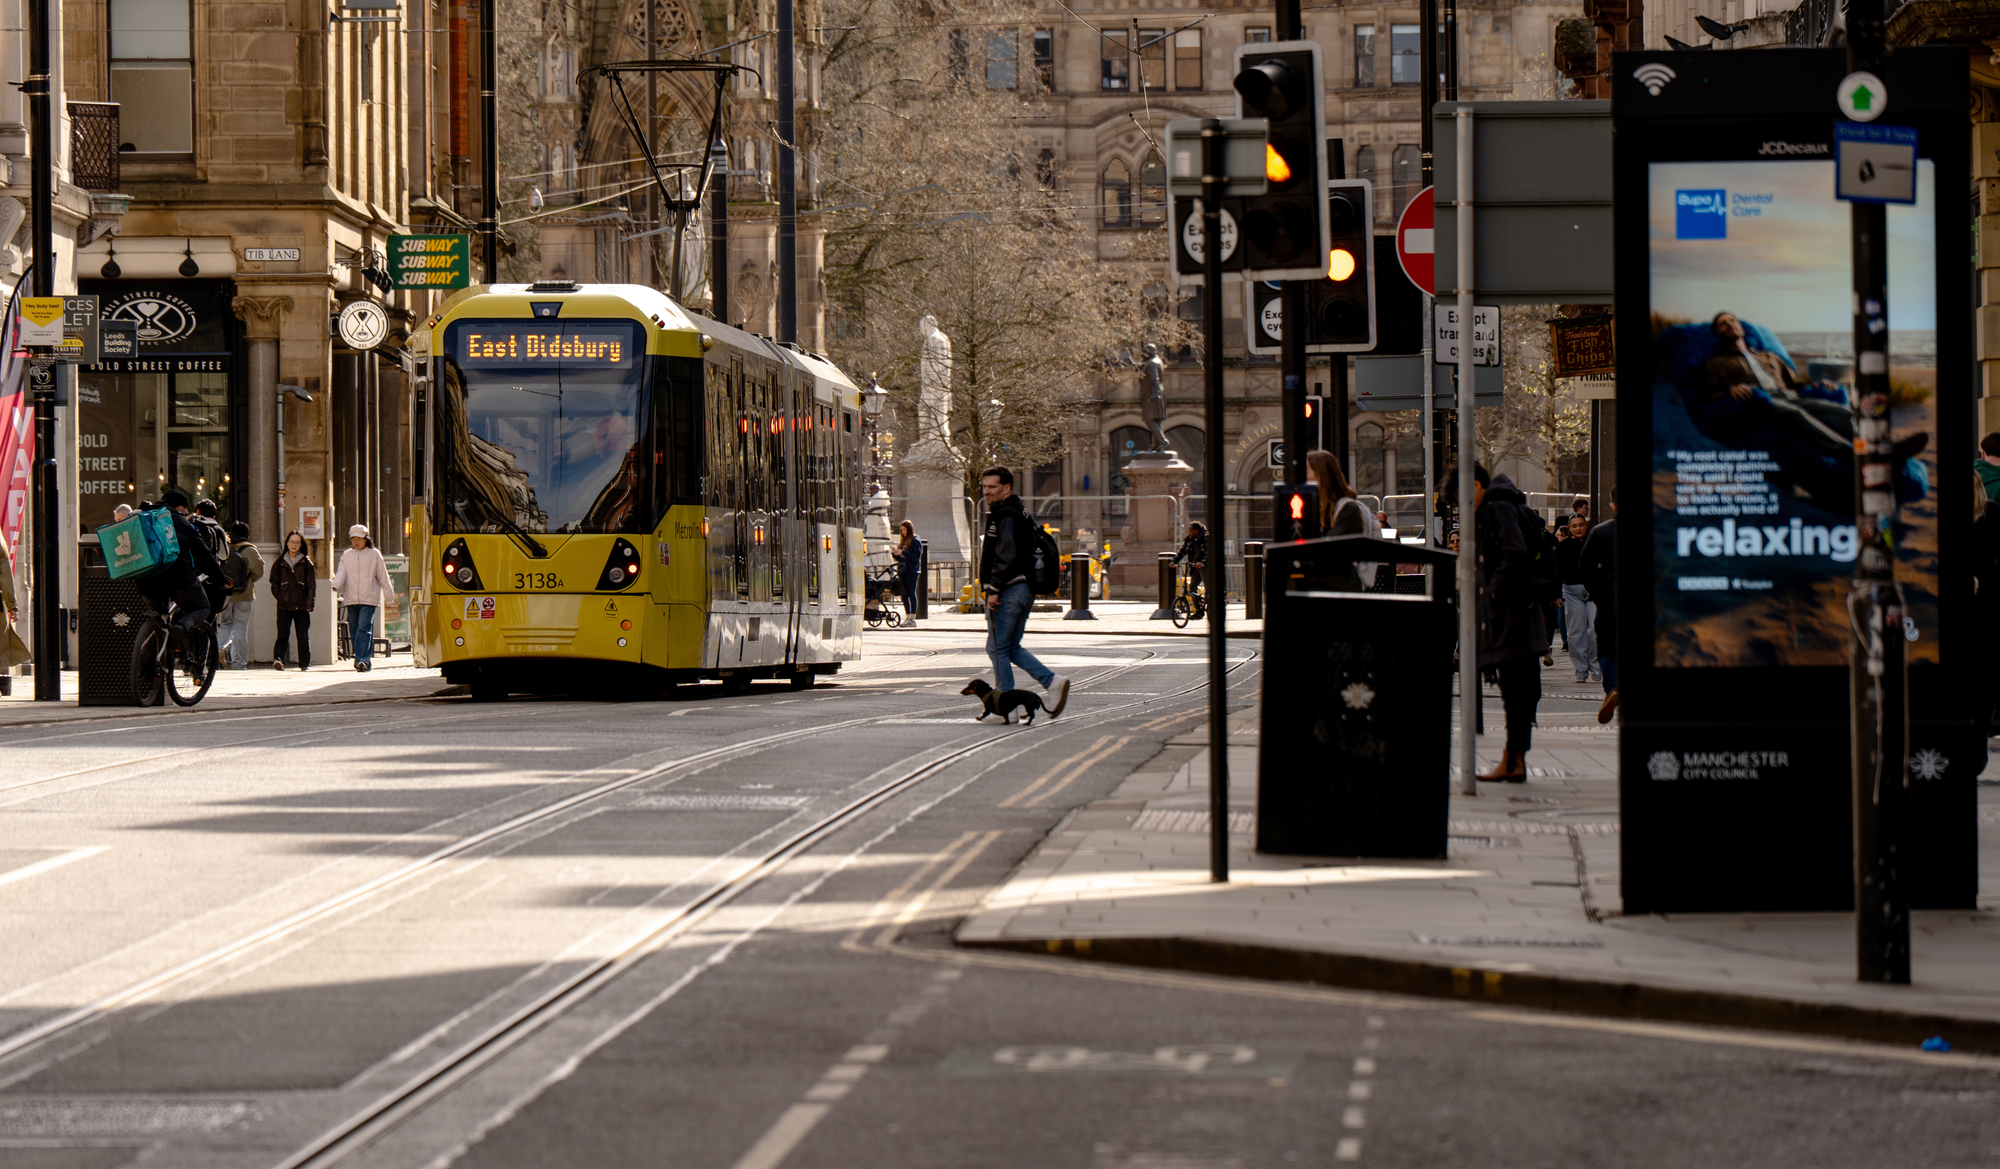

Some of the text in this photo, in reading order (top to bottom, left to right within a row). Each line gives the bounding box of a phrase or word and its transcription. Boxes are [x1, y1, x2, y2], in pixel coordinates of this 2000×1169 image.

[1759, 142, 1829, 155] JCDecaux
[1678, 193, 1712, 207] Bupa
[1732, 193, 1773, 204] Dental
[1732, 206, 1761, 216] Care
[398, 238, 459, 252] SUBWAY
[248, 250, 297, 259] TIB LANE
[398, 254, 459, 268] SUBWAY
[398, 271, 459, 285] SUBWAY
[63, 300, 93, 310] ICES
[103, 291, 196, 316] BOLD STREET COFFEE
[370, 304, 384, 318] COFFEE
[64, 313, 93, 325] LET
[1440, 327, 1494, 341] tra and
[1566, 329, 1602, 339] Traditional
[104, 339, 132, 347] Building
[104, 346, 131, 354] Society
[469, 335, 621, 362] East Didsbury
[1567, 337, 1598, 352] Fish
[1567, 351, 1605, 365] Chips
[90, 361, 222, 370] BOLD STREET COFFEE
[1229, 422, 1278, 464] CARLTON
[1677, 518, 1859, 562] relaxing
[114, 553, 142, 567] deliveroo
[1683, 752, 1789, 768] MANCHESTER
[1684, 769, 1759, 780] CITY COUNCIL
